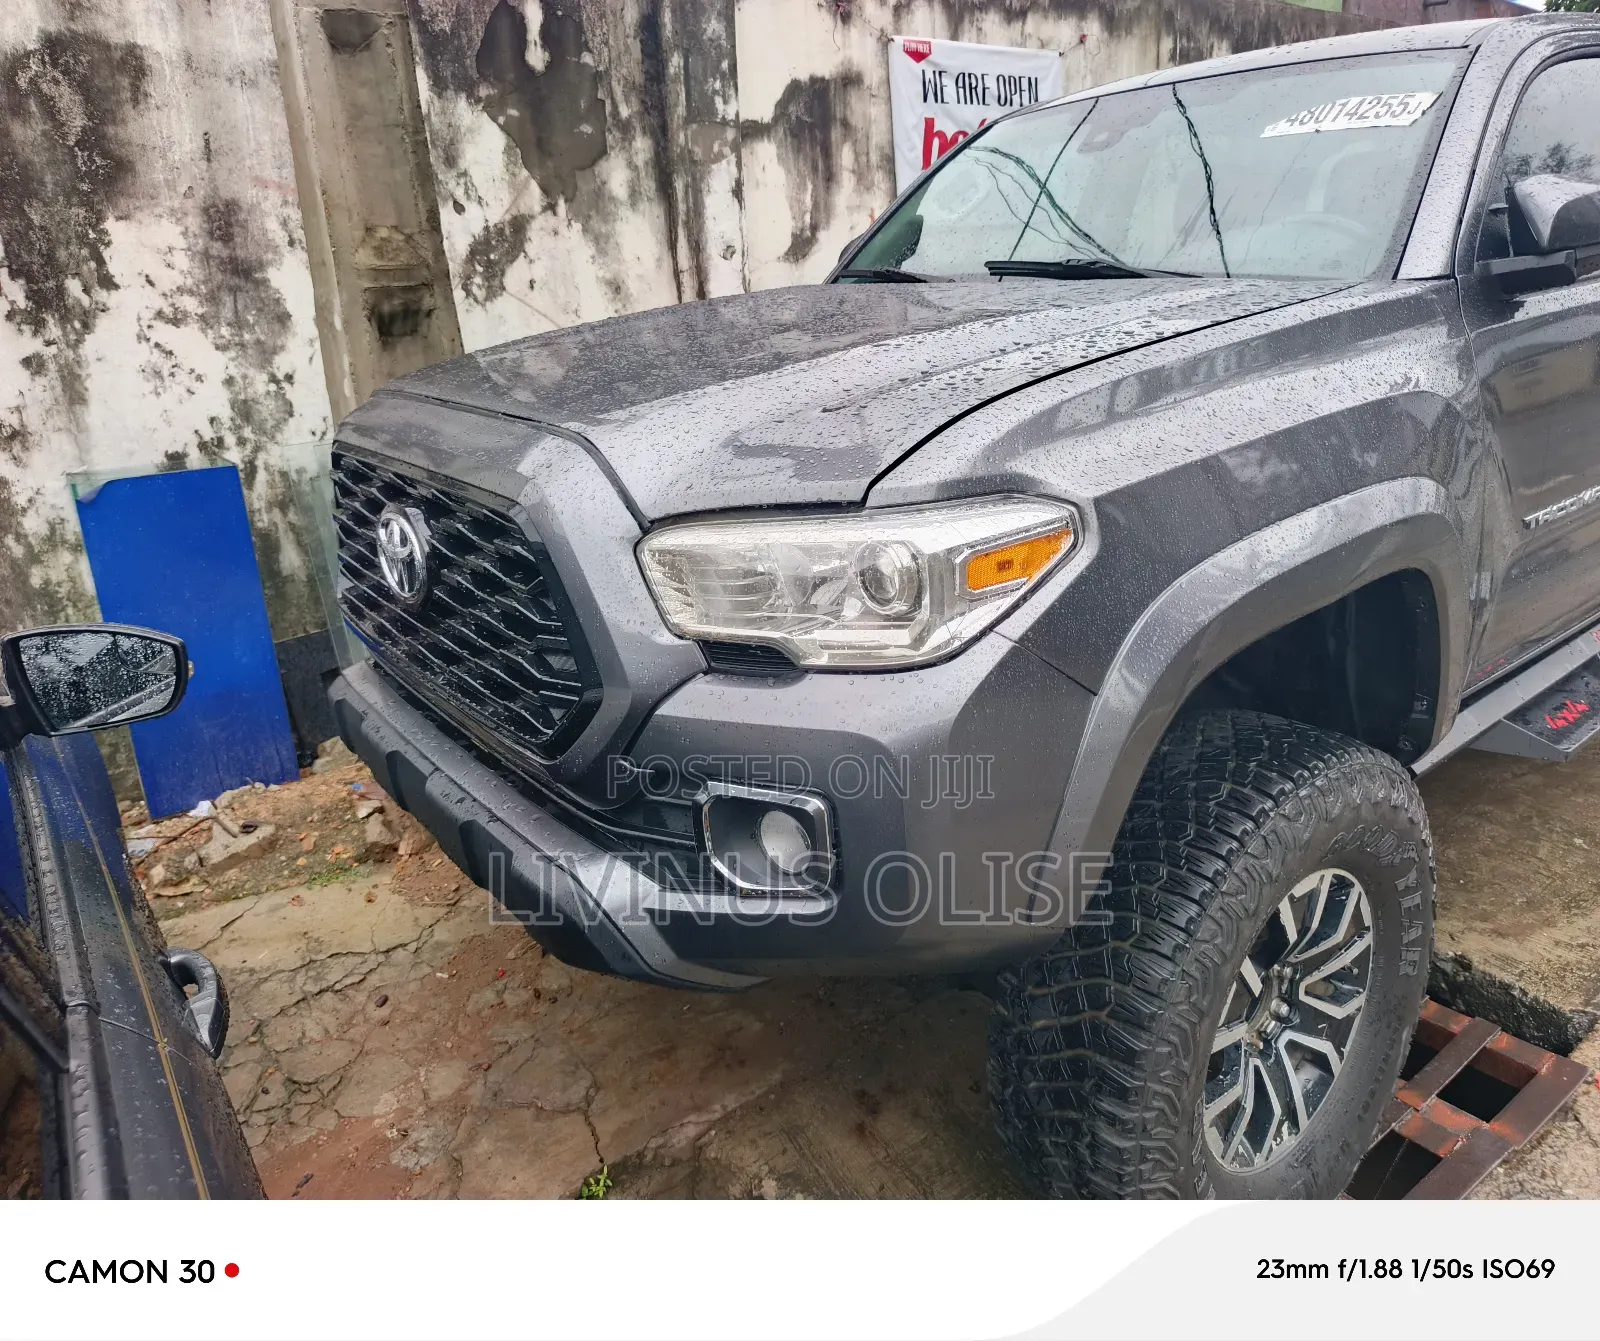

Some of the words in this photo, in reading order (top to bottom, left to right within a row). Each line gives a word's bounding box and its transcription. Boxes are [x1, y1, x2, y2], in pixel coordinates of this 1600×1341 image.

[921, 69, 949, 104] WE
[954, 72, 991, 107] ARE
[996, 74, 1039, 107] OPEN
